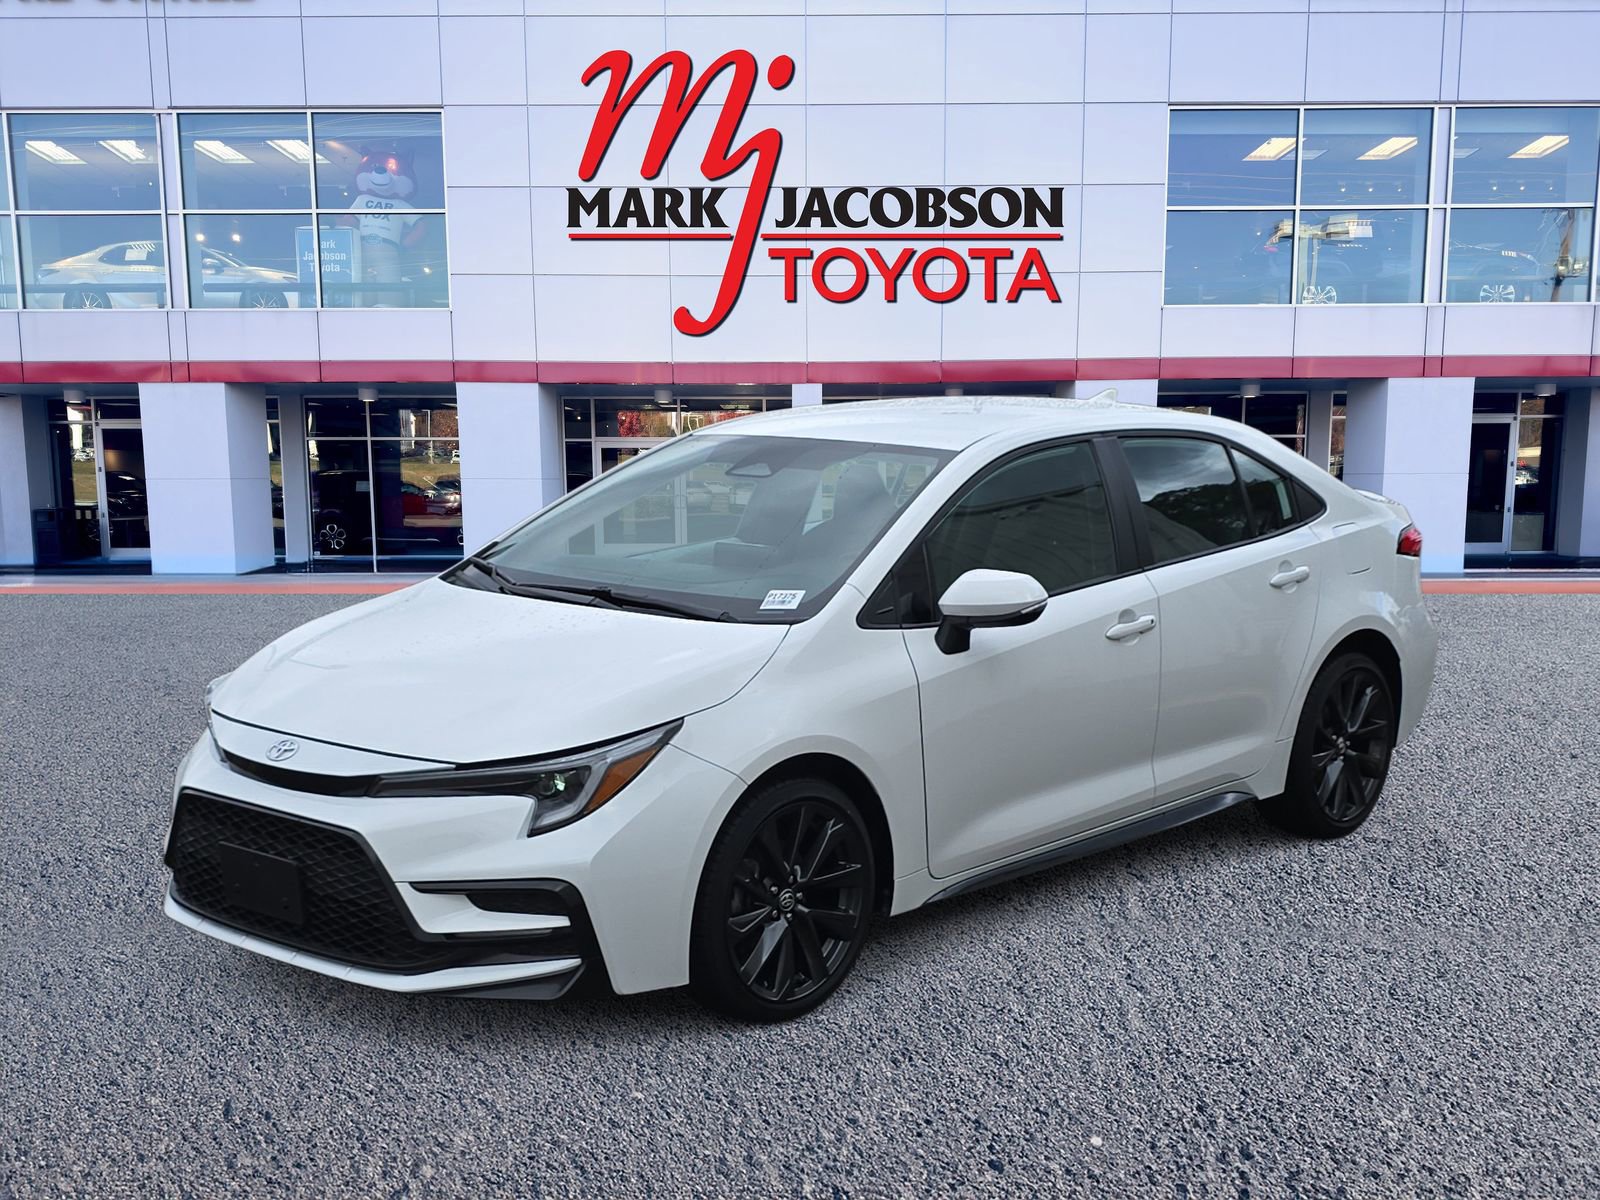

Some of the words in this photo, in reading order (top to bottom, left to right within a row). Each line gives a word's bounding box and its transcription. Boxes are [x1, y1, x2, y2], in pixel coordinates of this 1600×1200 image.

[365, 199, 394, 209] CAR
[565, 187, 729, 228] MARK
[774, 187, 1064, 228] JACOBSON
[313, 239, 336, 249] ark
[309, 262, 341, 273] Tyota
[768, 247, 1062, 303] TOYOTA
